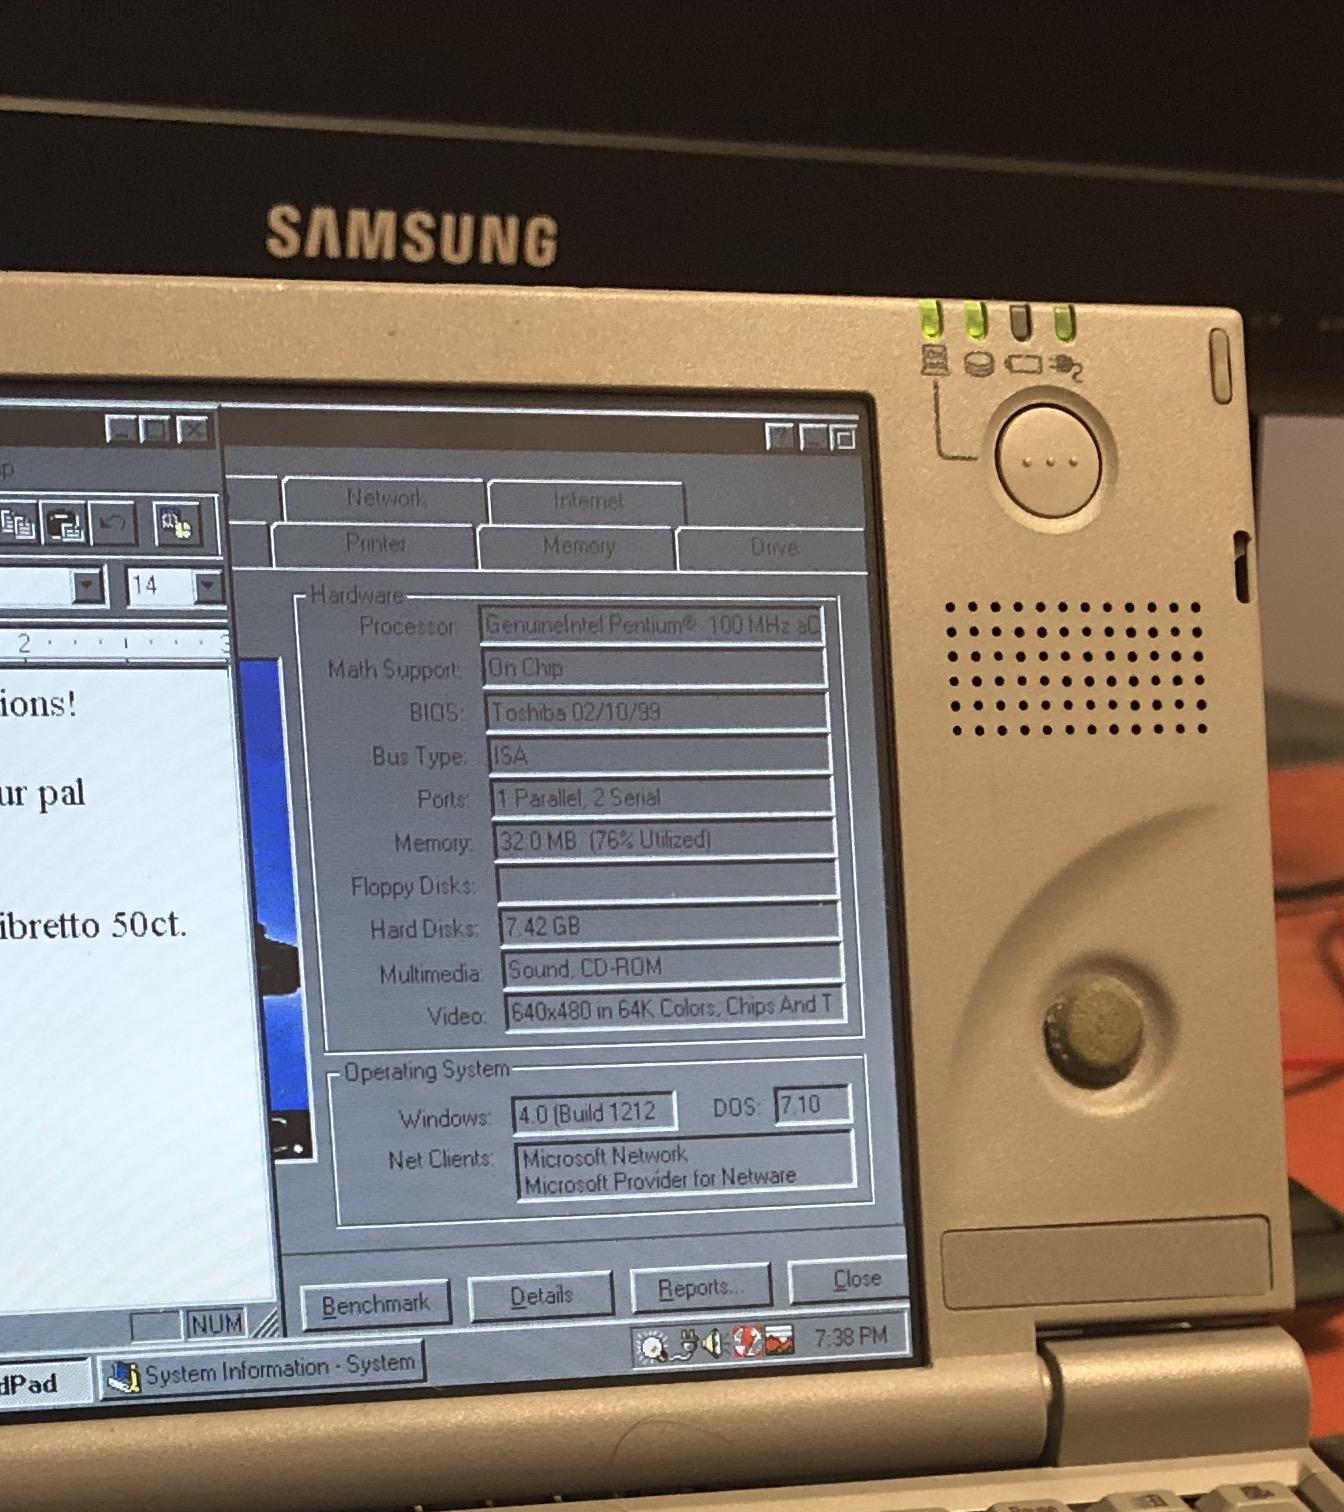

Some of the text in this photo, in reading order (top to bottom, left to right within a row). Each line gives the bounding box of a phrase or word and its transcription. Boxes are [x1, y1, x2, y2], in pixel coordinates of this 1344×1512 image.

[264, 202, 559, 268] SAMSUNG
[346, 486, 426, 507] Network
[555, 489, 624, 510] Internet
[346, 533, 408, 554] Printer
[544, 535, 617, 559] Memory
[751, 536, 801, 558] Drive
[133, 574, 158, 596] 14
[310, 583, 405, 605] Hardware
[485, 613, 605, 636] GenuineIntel
[709, 613, 744, 635] 100
[748, 614, 790, 635] MHz
[328, 658, 378, 680] Math
[488, 656, 564, 682] On Chip
[493, 701, 662, 723] Toshiba 02/10/99
[372, 745, 468, 770] Bus Type:
[493, 745, 529, 766] ISA
[38, 777, 86, 815] pal
[497, 786, 662, 811] 1 Parallel, 2 Serial
[501, 828, 711, 853] 32.0 MB (76% Utilized)
[351, 875, 477, 899] Floppy Disks:
[111, 910, 187, 938] 50ct.
[371, 919, 479, 940] Hard Disks:
[506, 915, 581, 937] 7.42 GB
[508, 956, 663, 982] Sound, CD-ROM
[427, 1006, 487, 1027] Video:
[511, 994, 816, 1022] 640x480 in 64K Colors, Chips And
[344, 1059, 511, 1085] Operating System
[519, 1101, 656, 1128] 4.0 (Build 1212
[713, 1098, 762, 1118] DOS:
[781, 1095, 822, 1115] 7.10
[398, 1109, 493, 1129] Windows:
[389, 1148, 494, 1170] Net Clients:
[523, 1145, 689, 1170] Microsoft Network
[525, 1167, 797, 1196] Microsoft Provider for Netware
[833, 1268, 883, 1293] Close
[322, 1290, 432, 1320] Benchmark
[510, 1284, 574, 1310] Details
[192, 1313, 244, 1336] NUM
[815, 1325, 889, 1349] 7:38 PM
[144, 1351, 416, 1385] System Information System
